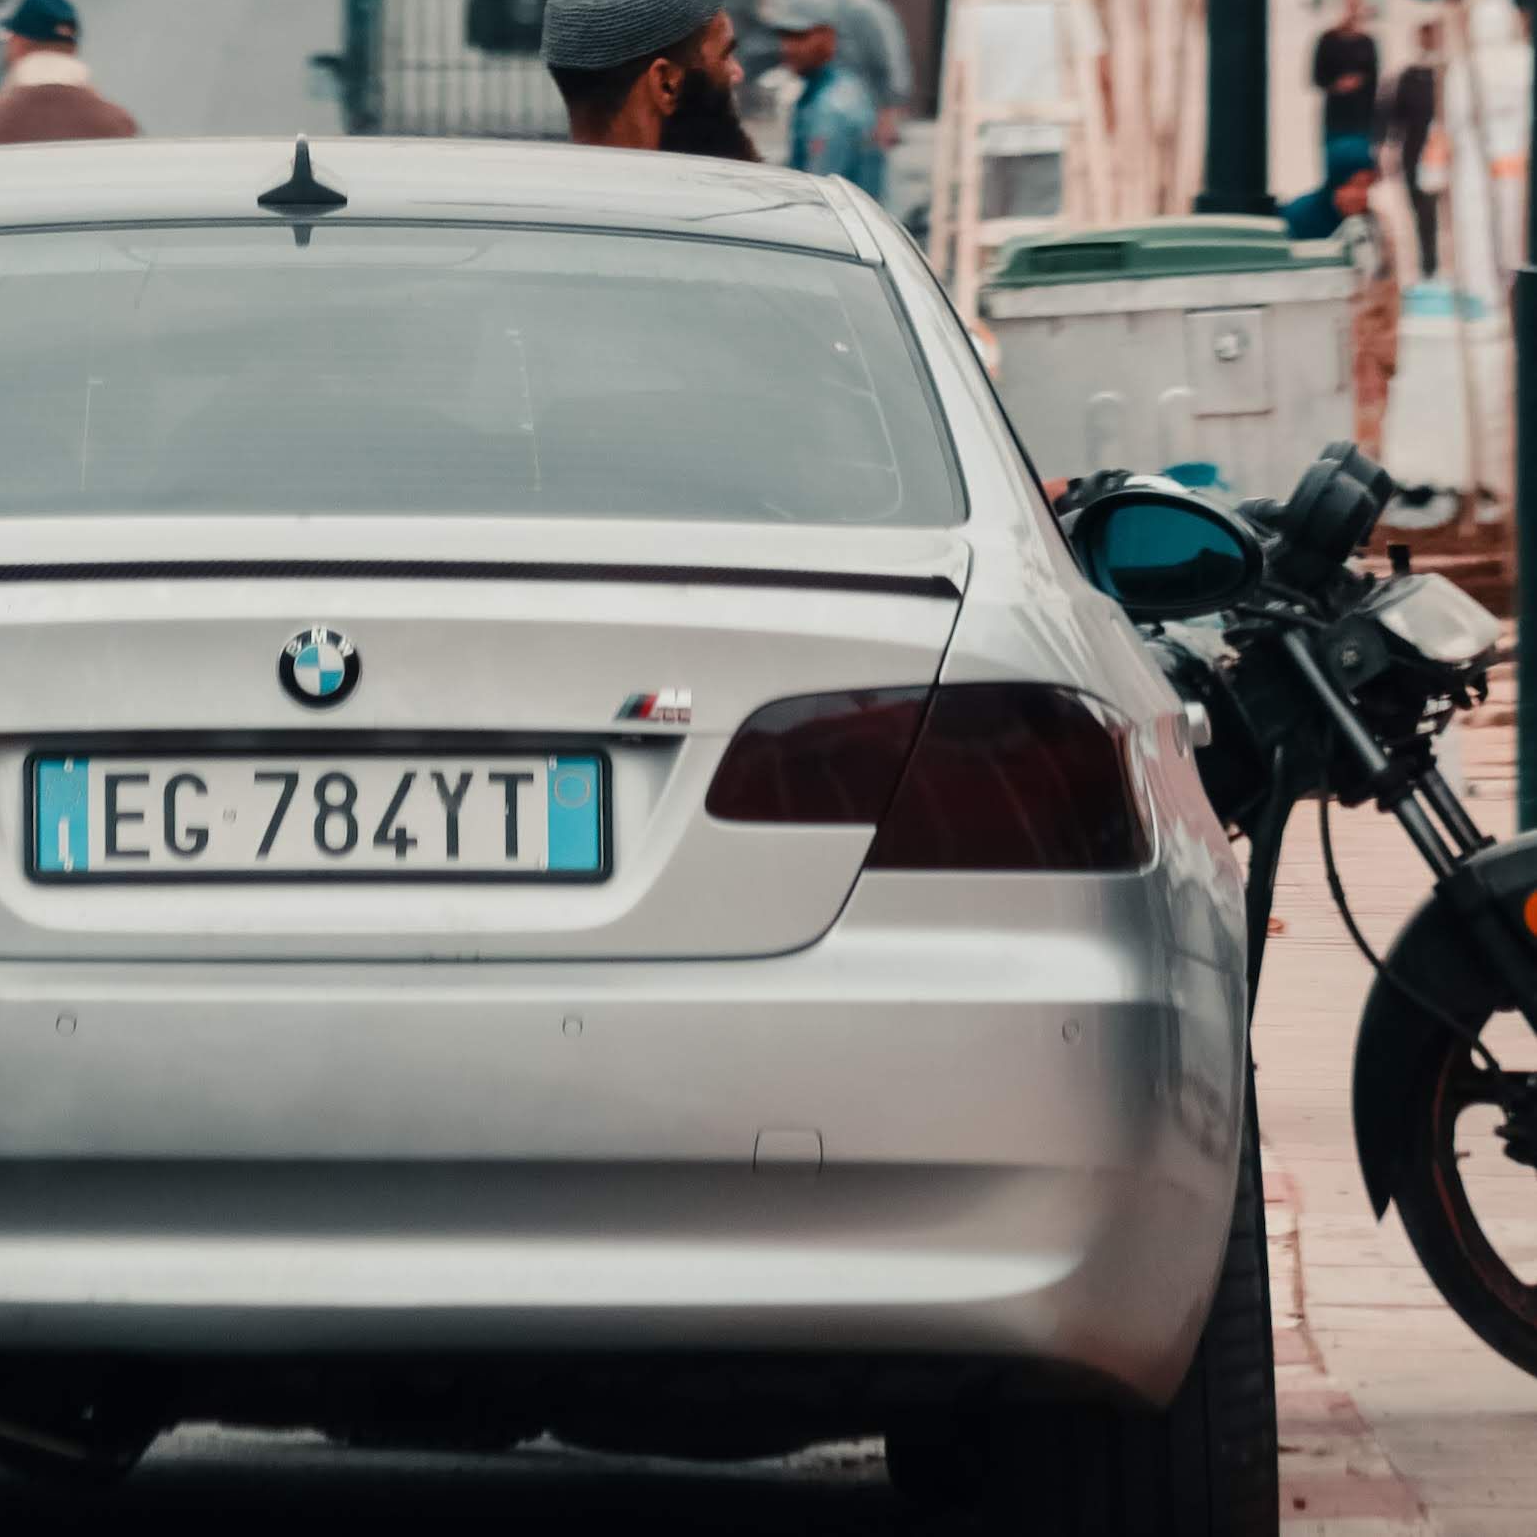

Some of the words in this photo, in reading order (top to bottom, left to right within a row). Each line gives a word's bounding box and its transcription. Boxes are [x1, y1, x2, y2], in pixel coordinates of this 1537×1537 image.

[284, 623, 355, 658] BMW
[104, 771, 211, 860] EG
[253, 770, 535, 862] 784YT
